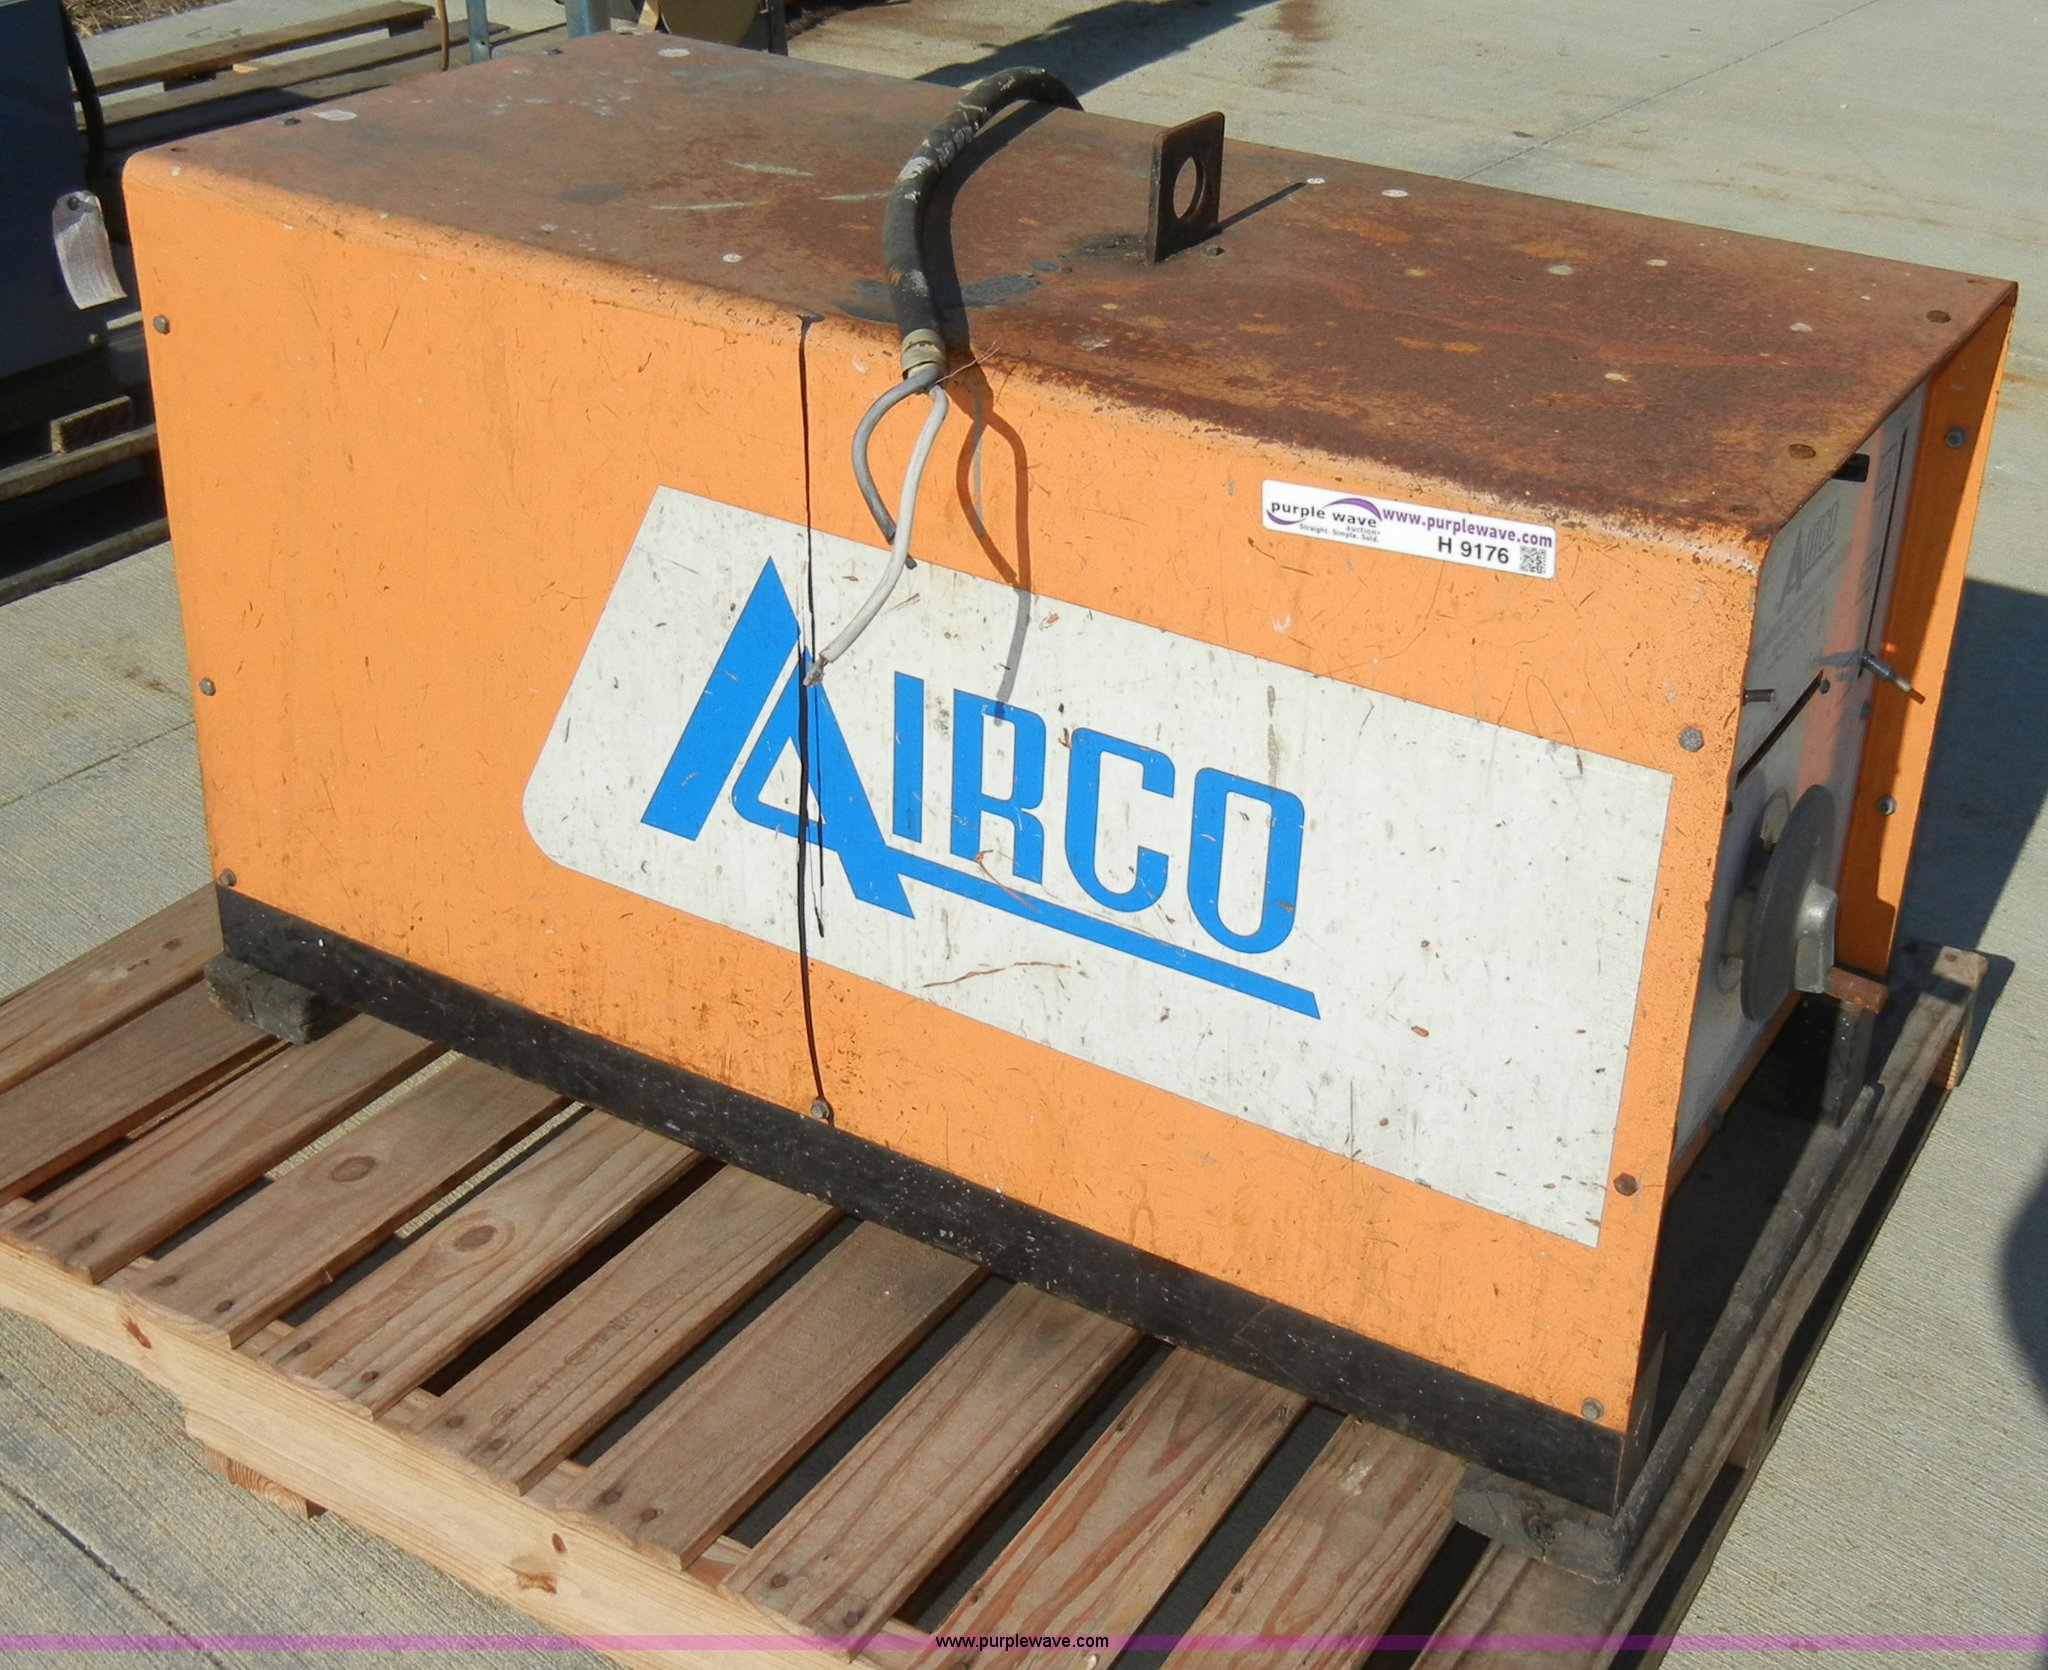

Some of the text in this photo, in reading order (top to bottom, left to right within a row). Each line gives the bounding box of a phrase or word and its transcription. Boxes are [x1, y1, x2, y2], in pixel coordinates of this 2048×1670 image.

[1271, 502, 1377, 528] purple wave
[1382, 508, 1553, 547] www.purplewave.com
[1438, 536, 1510, 565] H 9176
[640, 555, 1309, 960] AIRCO
